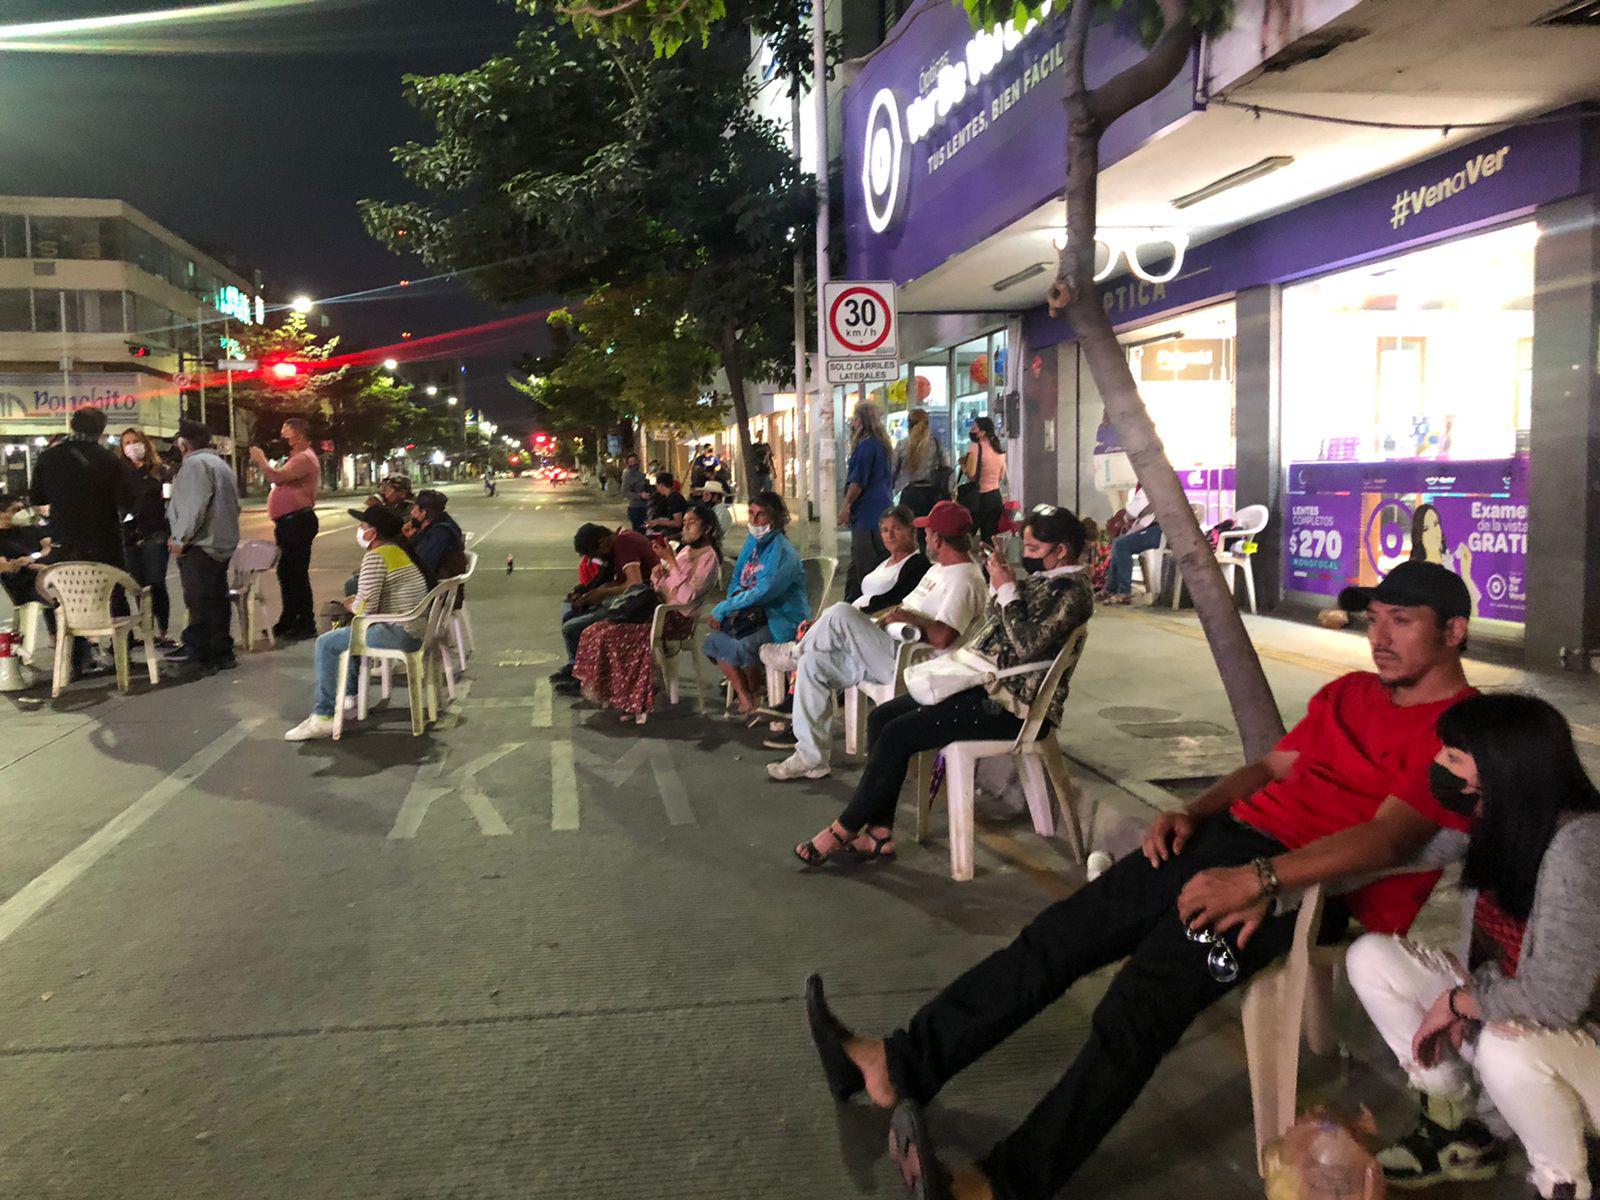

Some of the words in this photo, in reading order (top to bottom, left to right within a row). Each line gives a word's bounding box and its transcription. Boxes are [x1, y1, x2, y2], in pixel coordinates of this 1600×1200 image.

[927, 145, 946, 175] TUS
[946, 110, 989, 161] LENTES,
[991, 78, 1021, 123] BIEN
[1023, 41, 1065, 95] FÁCIL
[1390, 145, 1512, 230] #VenaVer
[1102, 281, 1167, 313] PTICA
[844, 298, 877, 327] 30
[829, 363, 853, 371] SOLO
[854, 361, 896, 370] CARRILES
[839, 371, 887, 380] LATERALES
[1292, 506, 1320, 516] LENTES
[1471, 501, 1528, 519] Exame
[1292, 516, 1335, 527] COMPLETOS
[1477, 520, 1491, 532] de
[1492, 521, 1502, 532] la
[1503, 521, 1528, 533] vista
[1289, 529, 1343, 560] $270
[1468, 533, 1528, 554] GRATI
